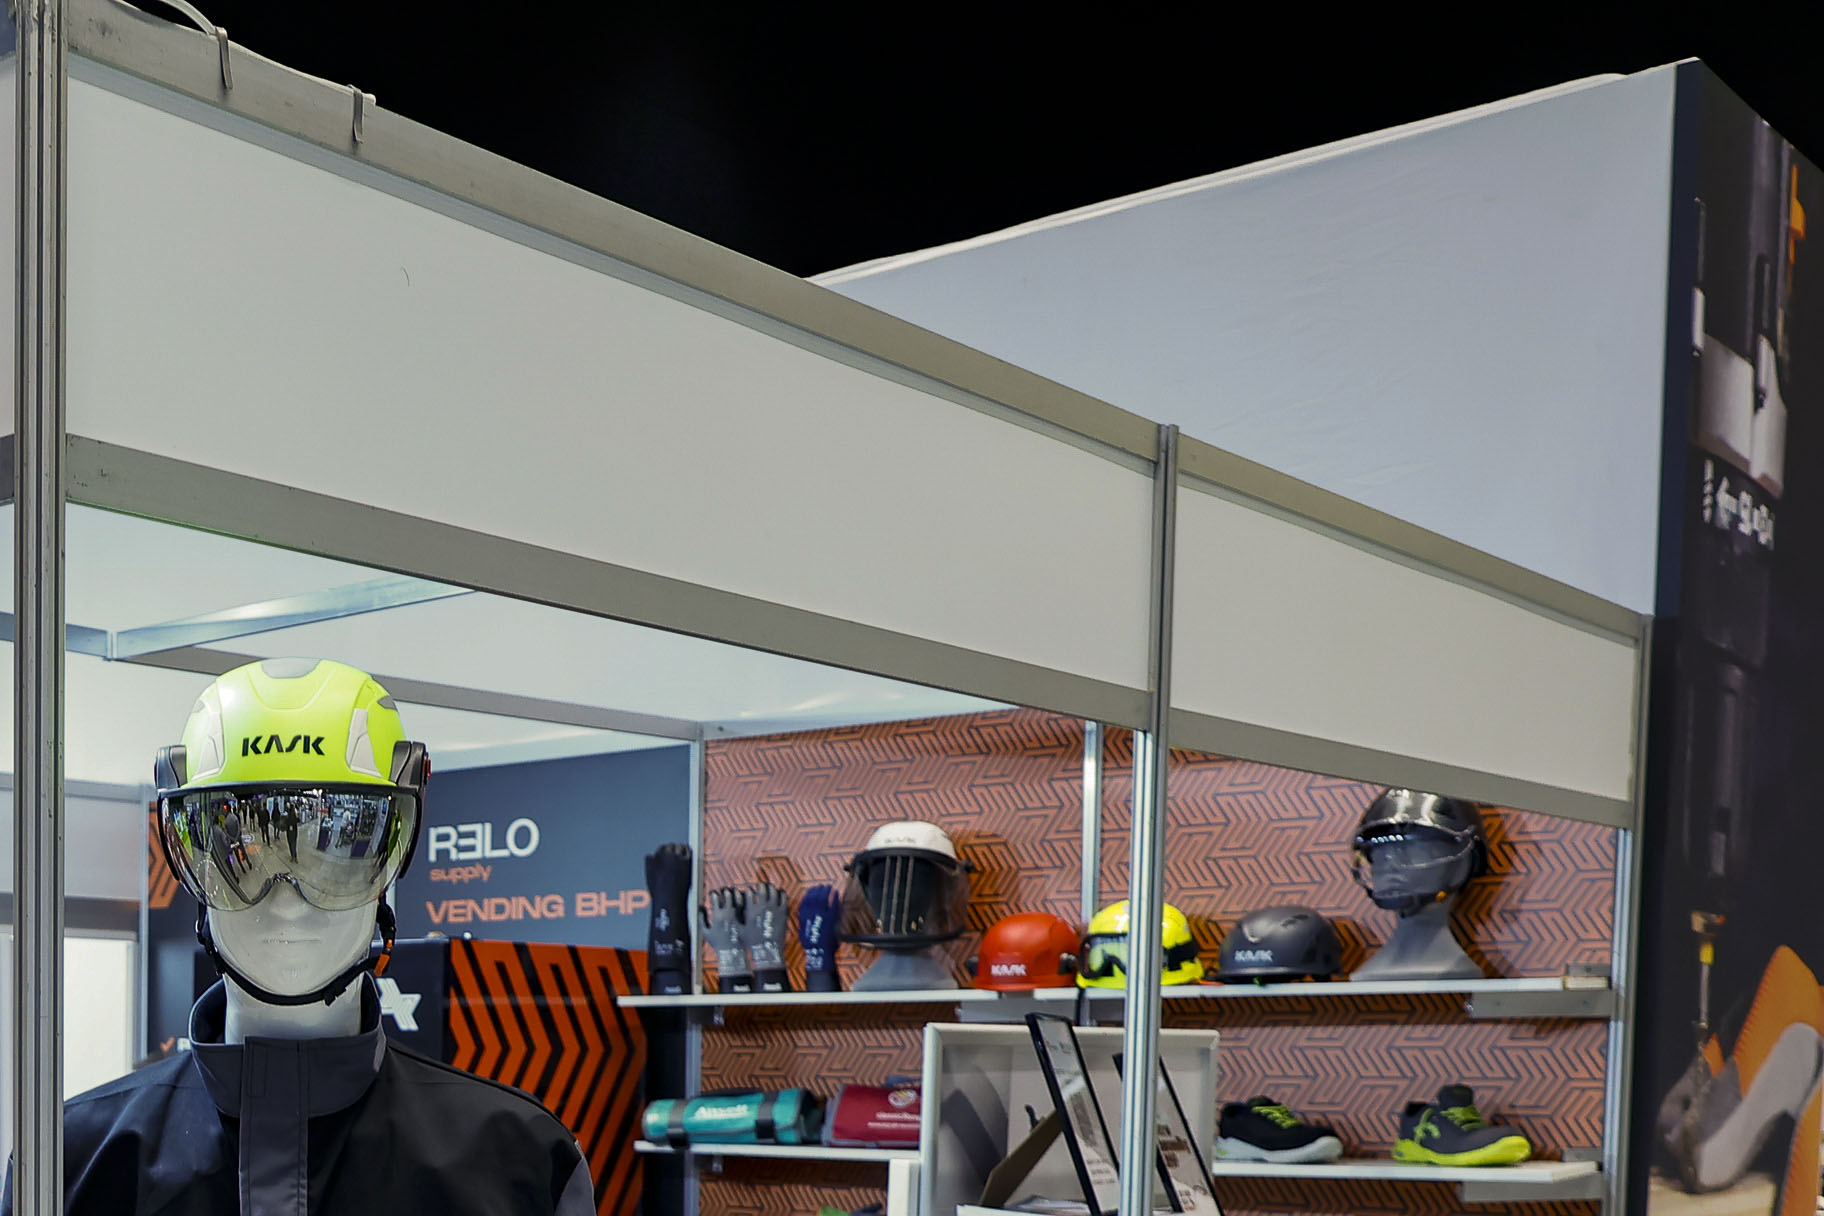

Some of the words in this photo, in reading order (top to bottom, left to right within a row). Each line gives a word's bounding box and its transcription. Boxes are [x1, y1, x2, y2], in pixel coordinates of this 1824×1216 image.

[241, 734, 325, 757] KASK
[430, 863, 493, 884] supply
[426, 894, 565, 924] VENDING
[575, 889, 651, 918] BHP
